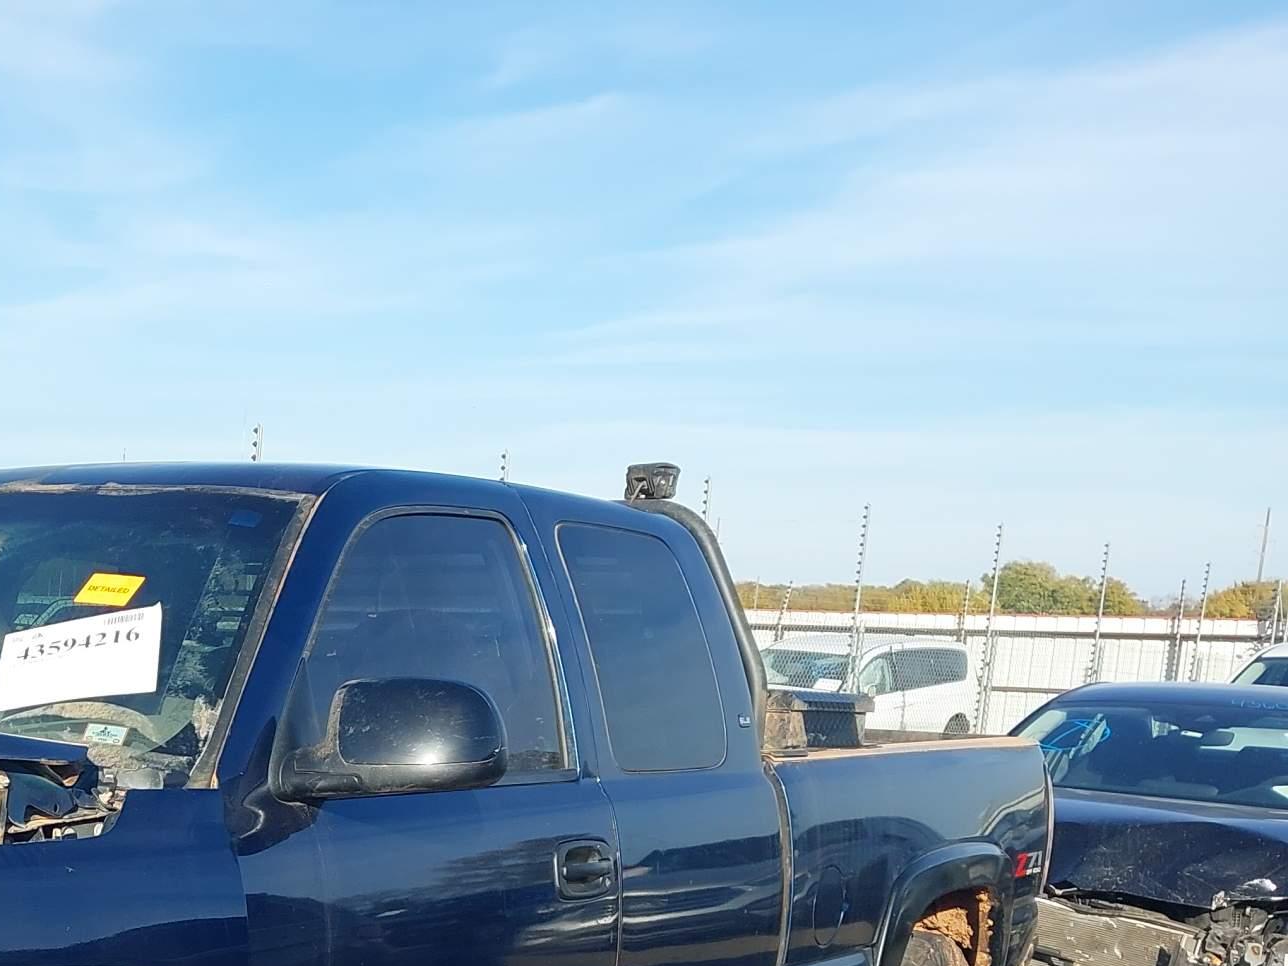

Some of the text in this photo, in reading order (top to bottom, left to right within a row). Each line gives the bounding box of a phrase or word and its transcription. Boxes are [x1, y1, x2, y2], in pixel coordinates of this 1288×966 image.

[87, 583, 130, 595] DETAILED
[16, 627, 141, 660] 43594216
[1015, 850, 1043, 878] Z71
